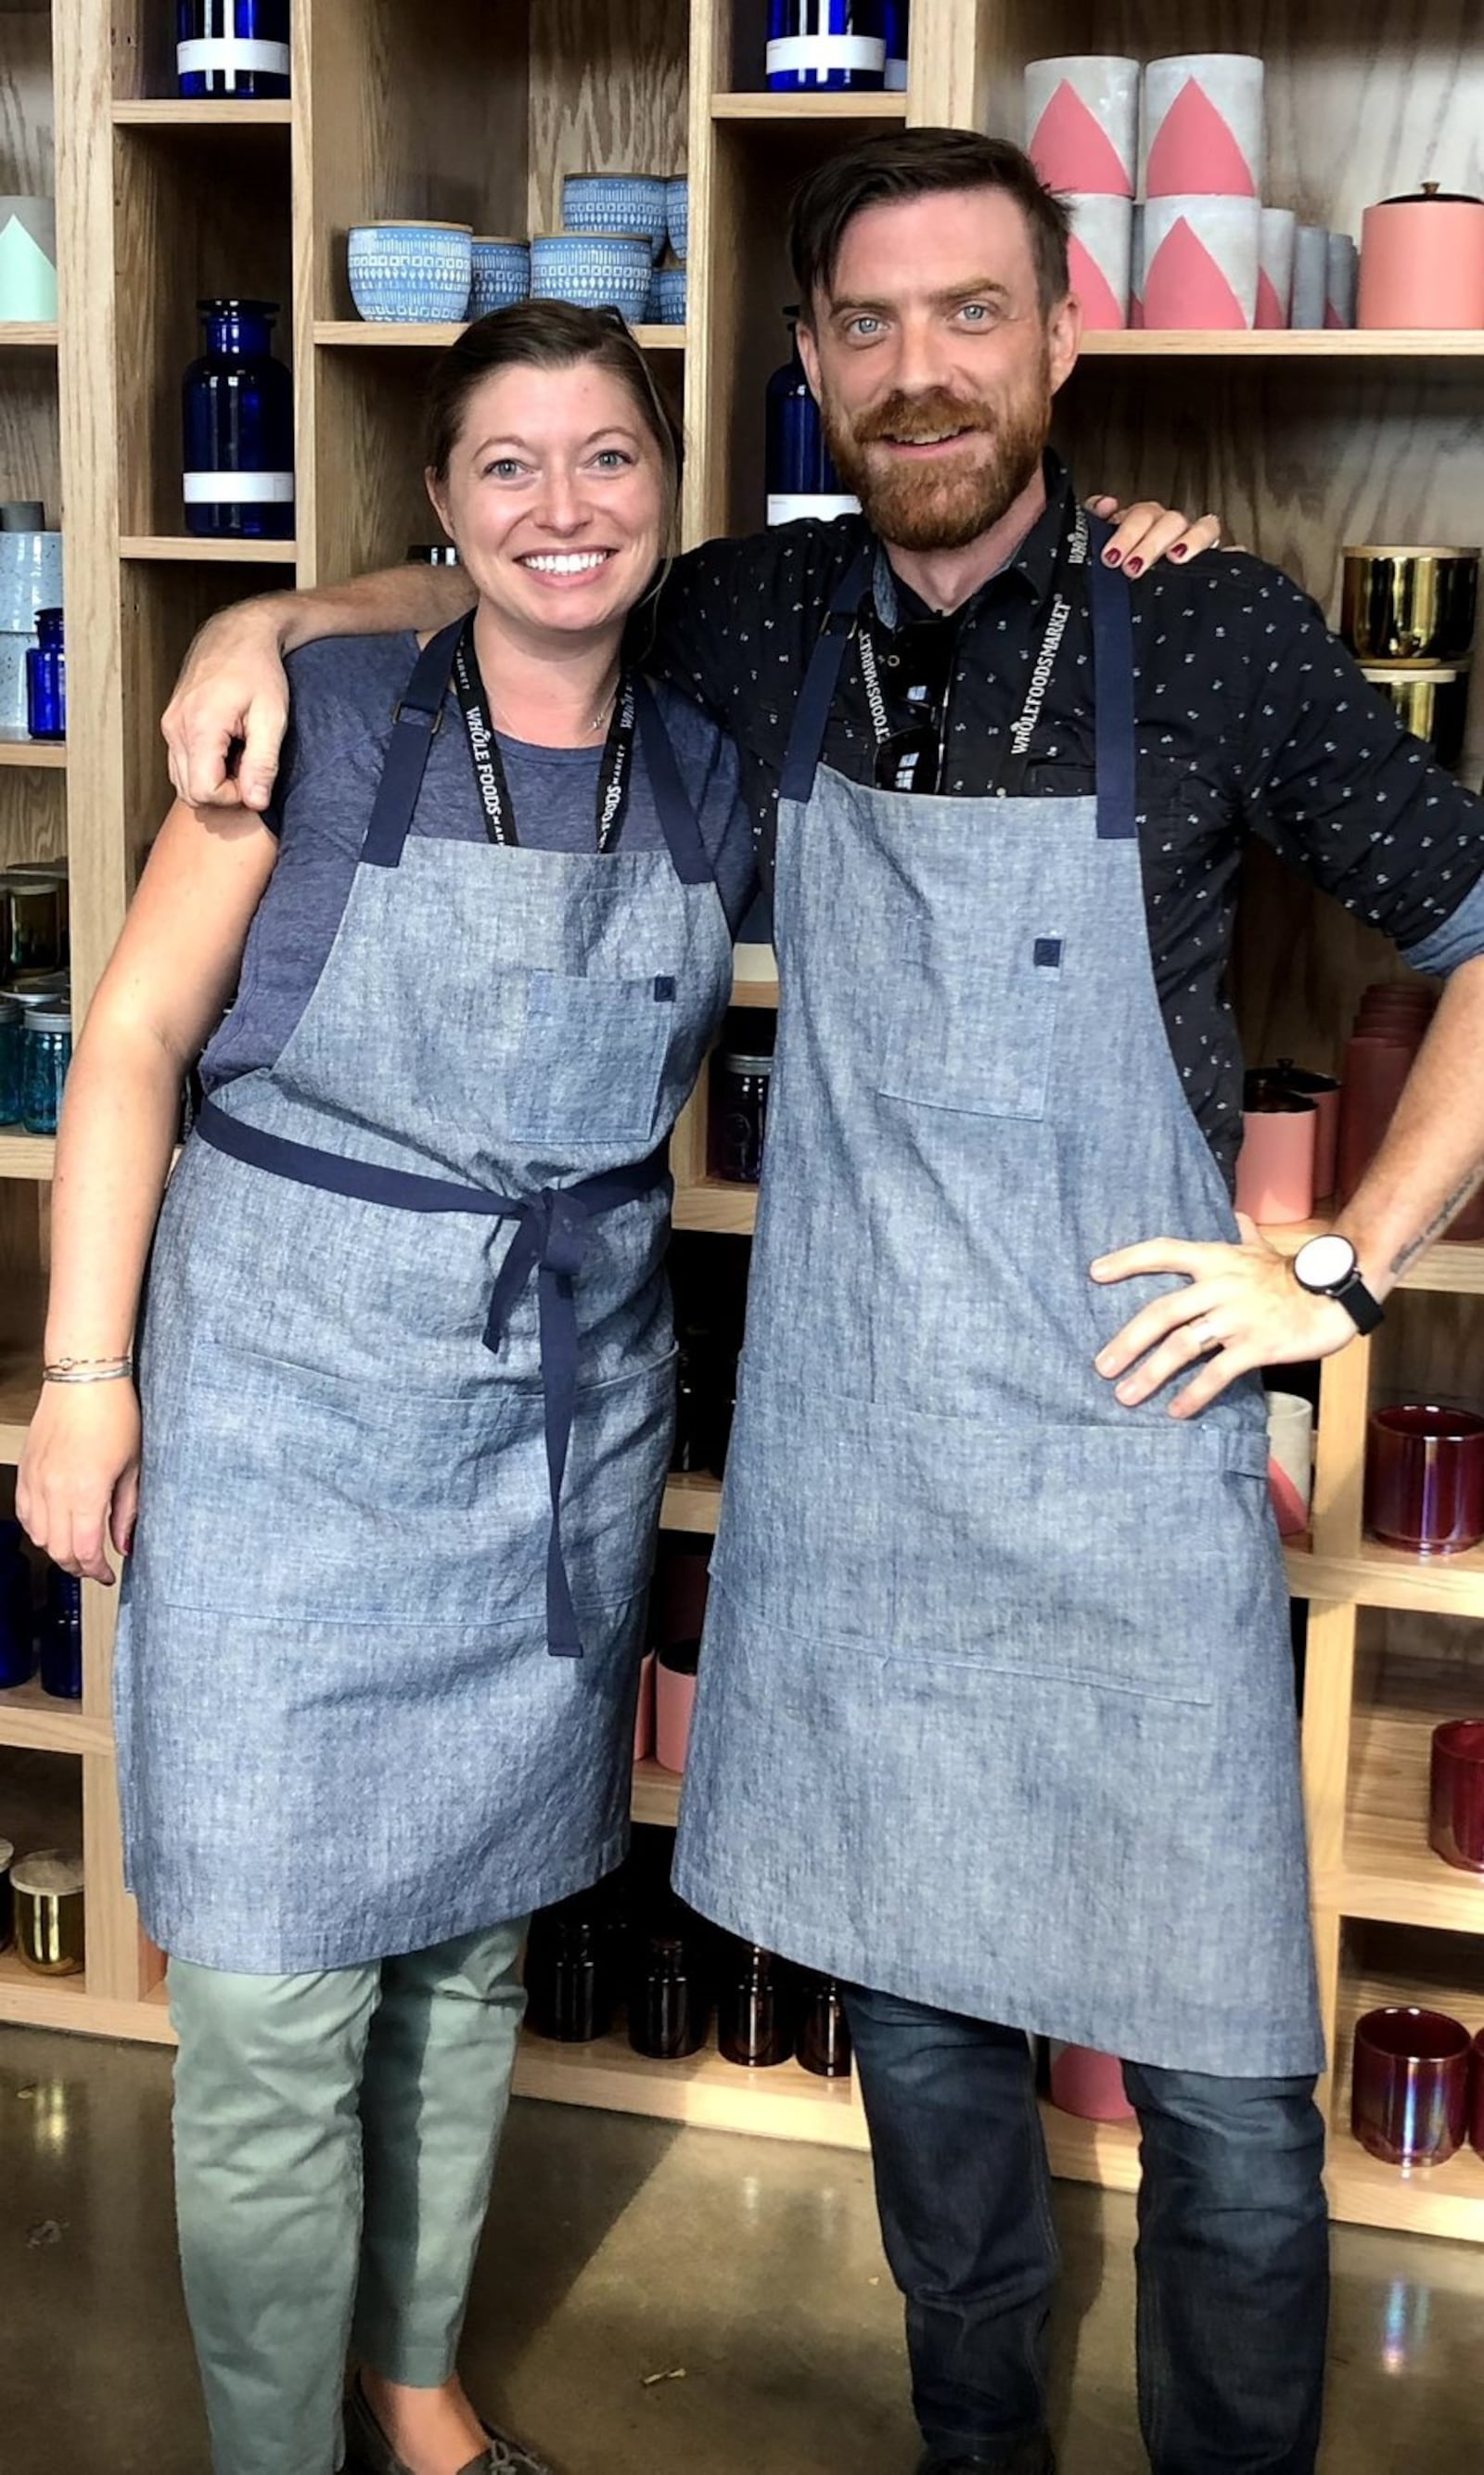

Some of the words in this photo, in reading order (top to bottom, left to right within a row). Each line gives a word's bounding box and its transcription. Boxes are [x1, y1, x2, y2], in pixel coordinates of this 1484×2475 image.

[466, 706, 492, 762] WHOLE
[477, 763, 503, 815] FOODS
[611, 744, 626, 786] MARKET
